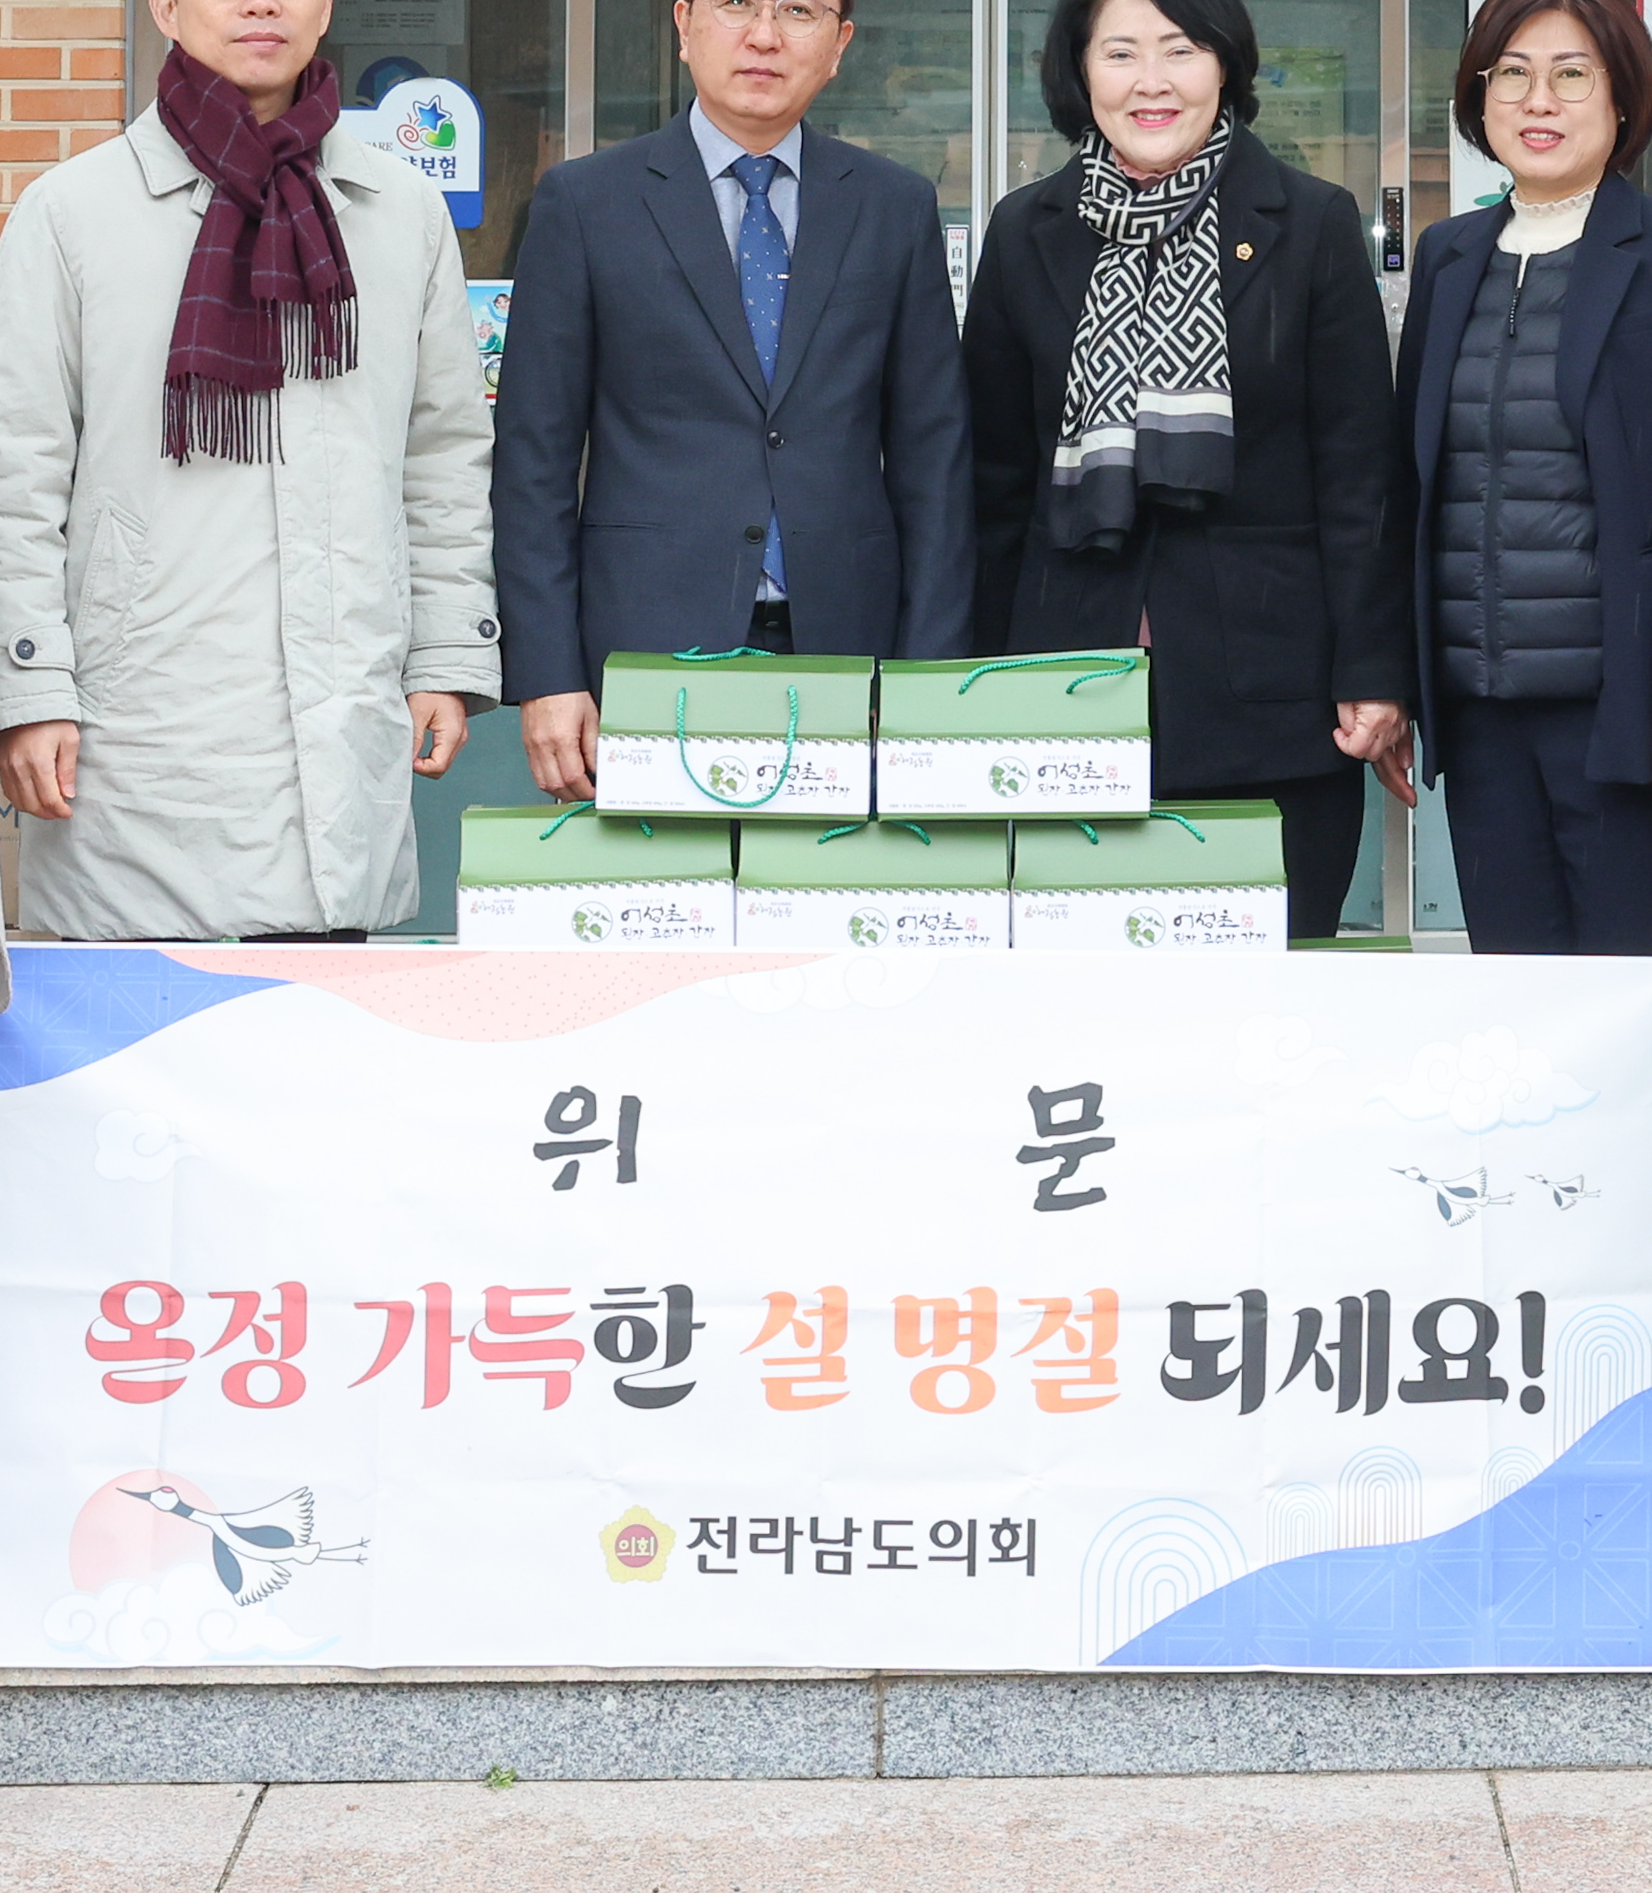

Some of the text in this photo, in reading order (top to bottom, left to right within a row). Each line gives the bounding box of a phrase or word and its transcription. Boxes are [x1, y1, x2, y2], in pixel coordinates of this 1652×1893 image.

[533, 1081, 1115, 1213] 위 문
[84, 1279, 1547, 1417] 온정 가득한 설 명절 되세요!
[617, 1536, 656, 1557] 의회
[686, 1515, 1037, 1578] 전라남도의회
